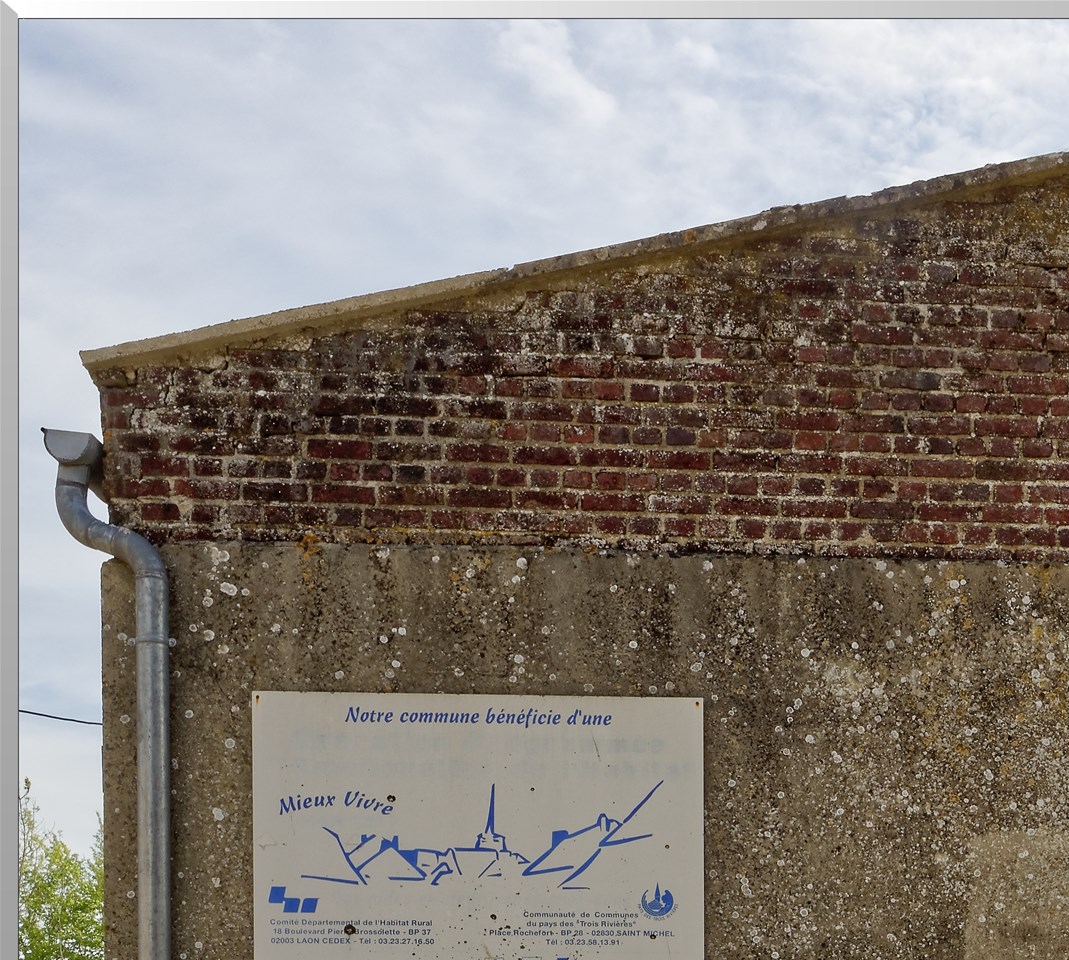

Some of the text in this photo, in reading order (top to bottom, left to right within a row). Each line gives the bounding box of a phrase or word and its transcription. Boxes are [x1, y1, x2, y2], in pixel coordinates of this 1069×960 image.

[345, 706, 612, 728] Notre commune bénéficie d'une
[279, 792, 394, 815] Mieux Vivre
[594, 911, 639, 919] Communes
[301, 919, 361, 927] Départemental
